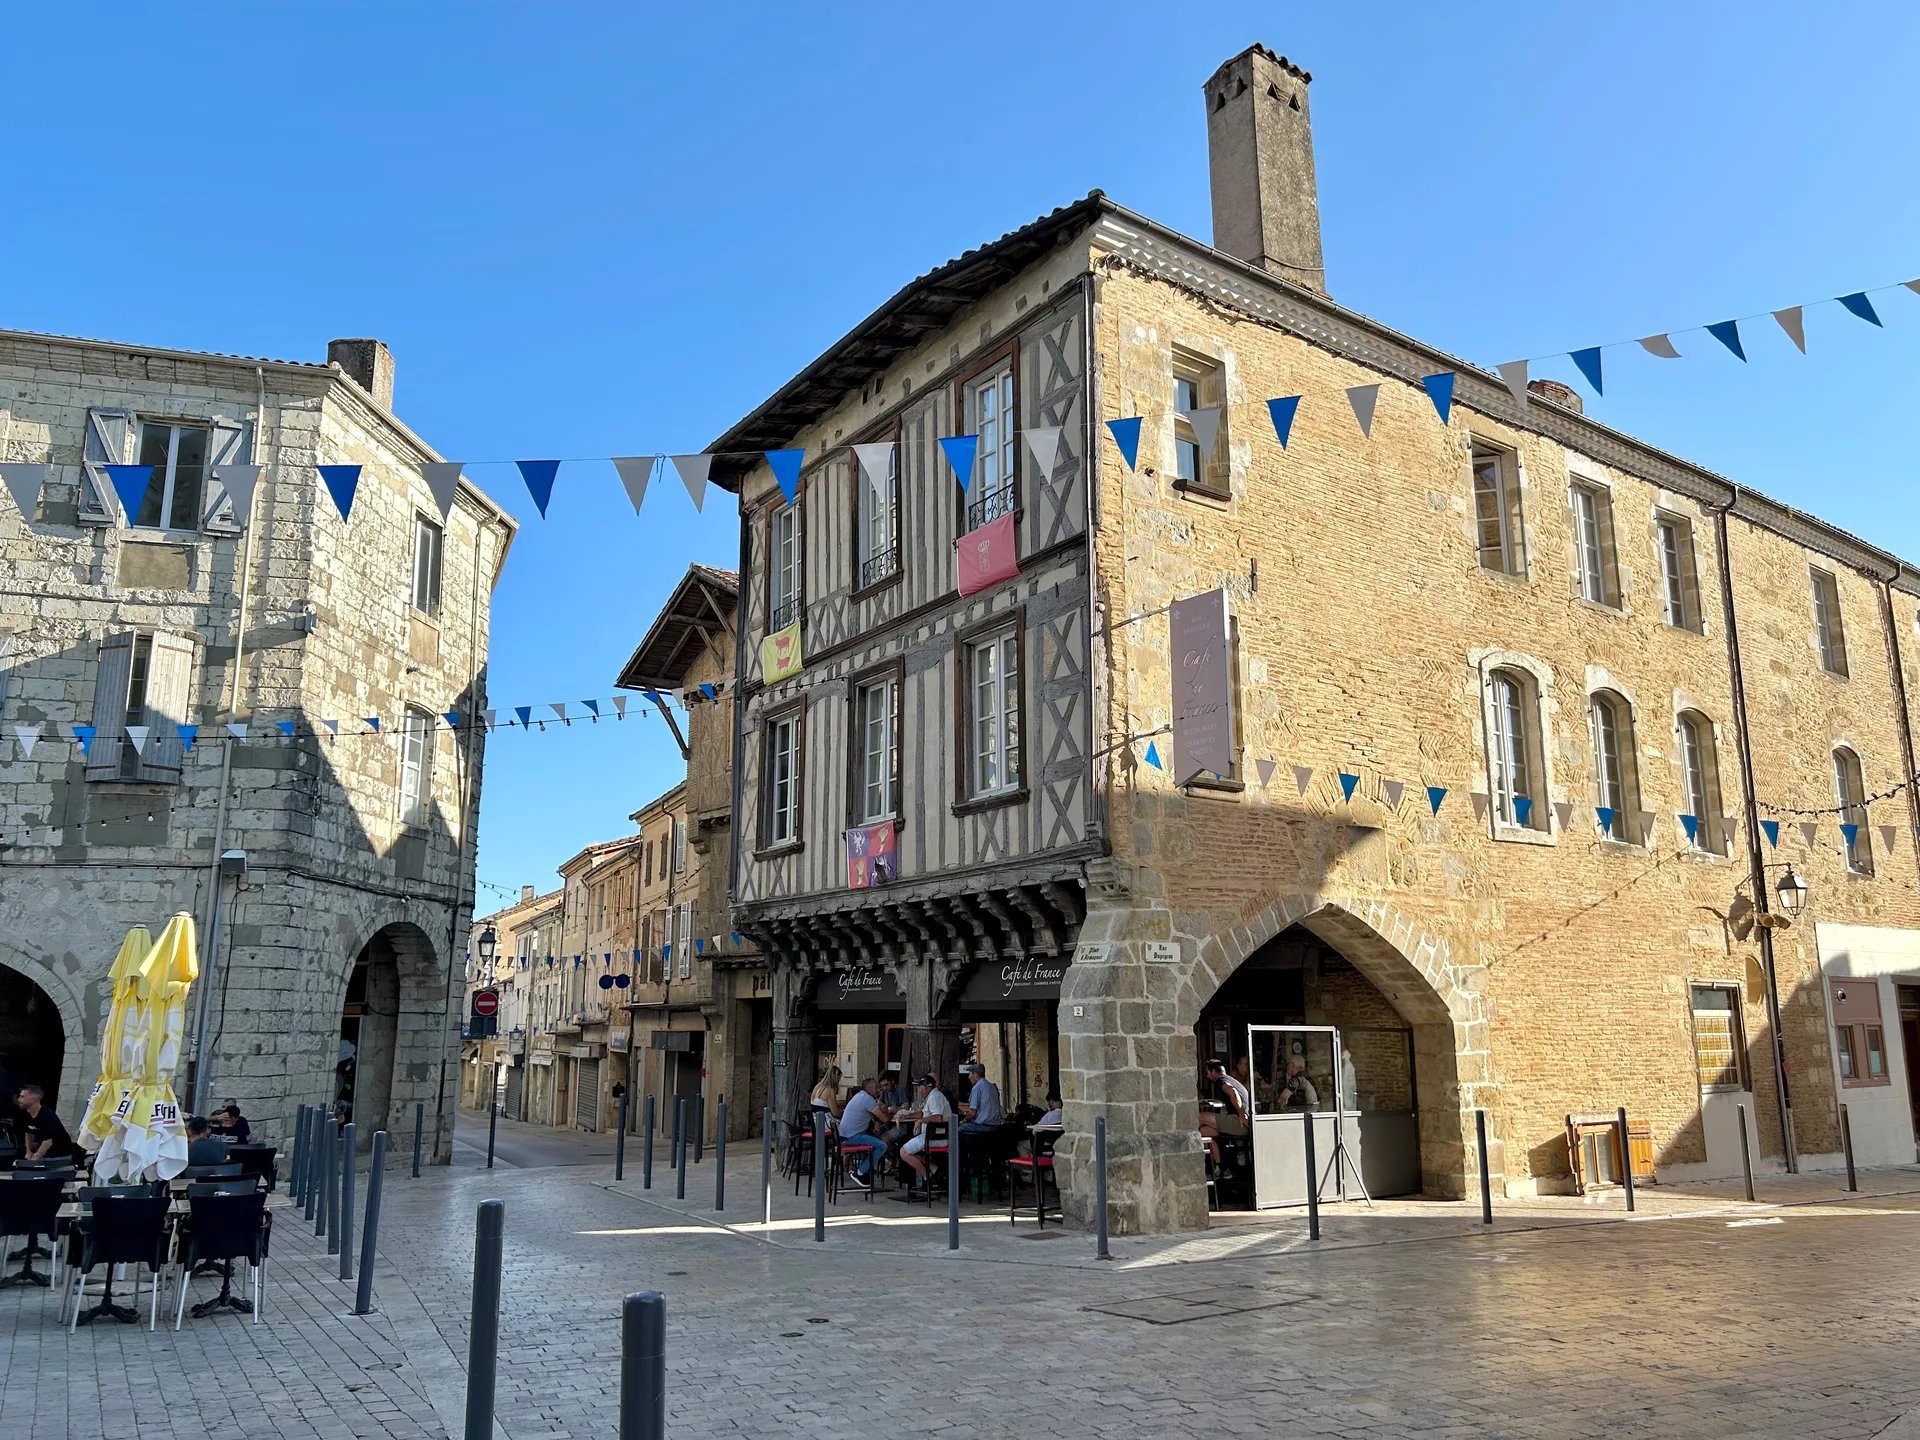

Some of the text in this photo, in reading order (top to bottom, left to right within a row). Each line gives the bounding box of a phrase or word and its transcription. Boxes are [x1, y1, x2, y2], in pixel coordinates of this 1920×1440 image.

[1180, 699, 1219, 719] France
[1183, 722, 1218, 736] RESTAURANT
[1185, 736, 1216, 748] CHAMBRES
[839, 966, 882, 1000] Café de France
[1002, 956, 1061, 997] Café de France
